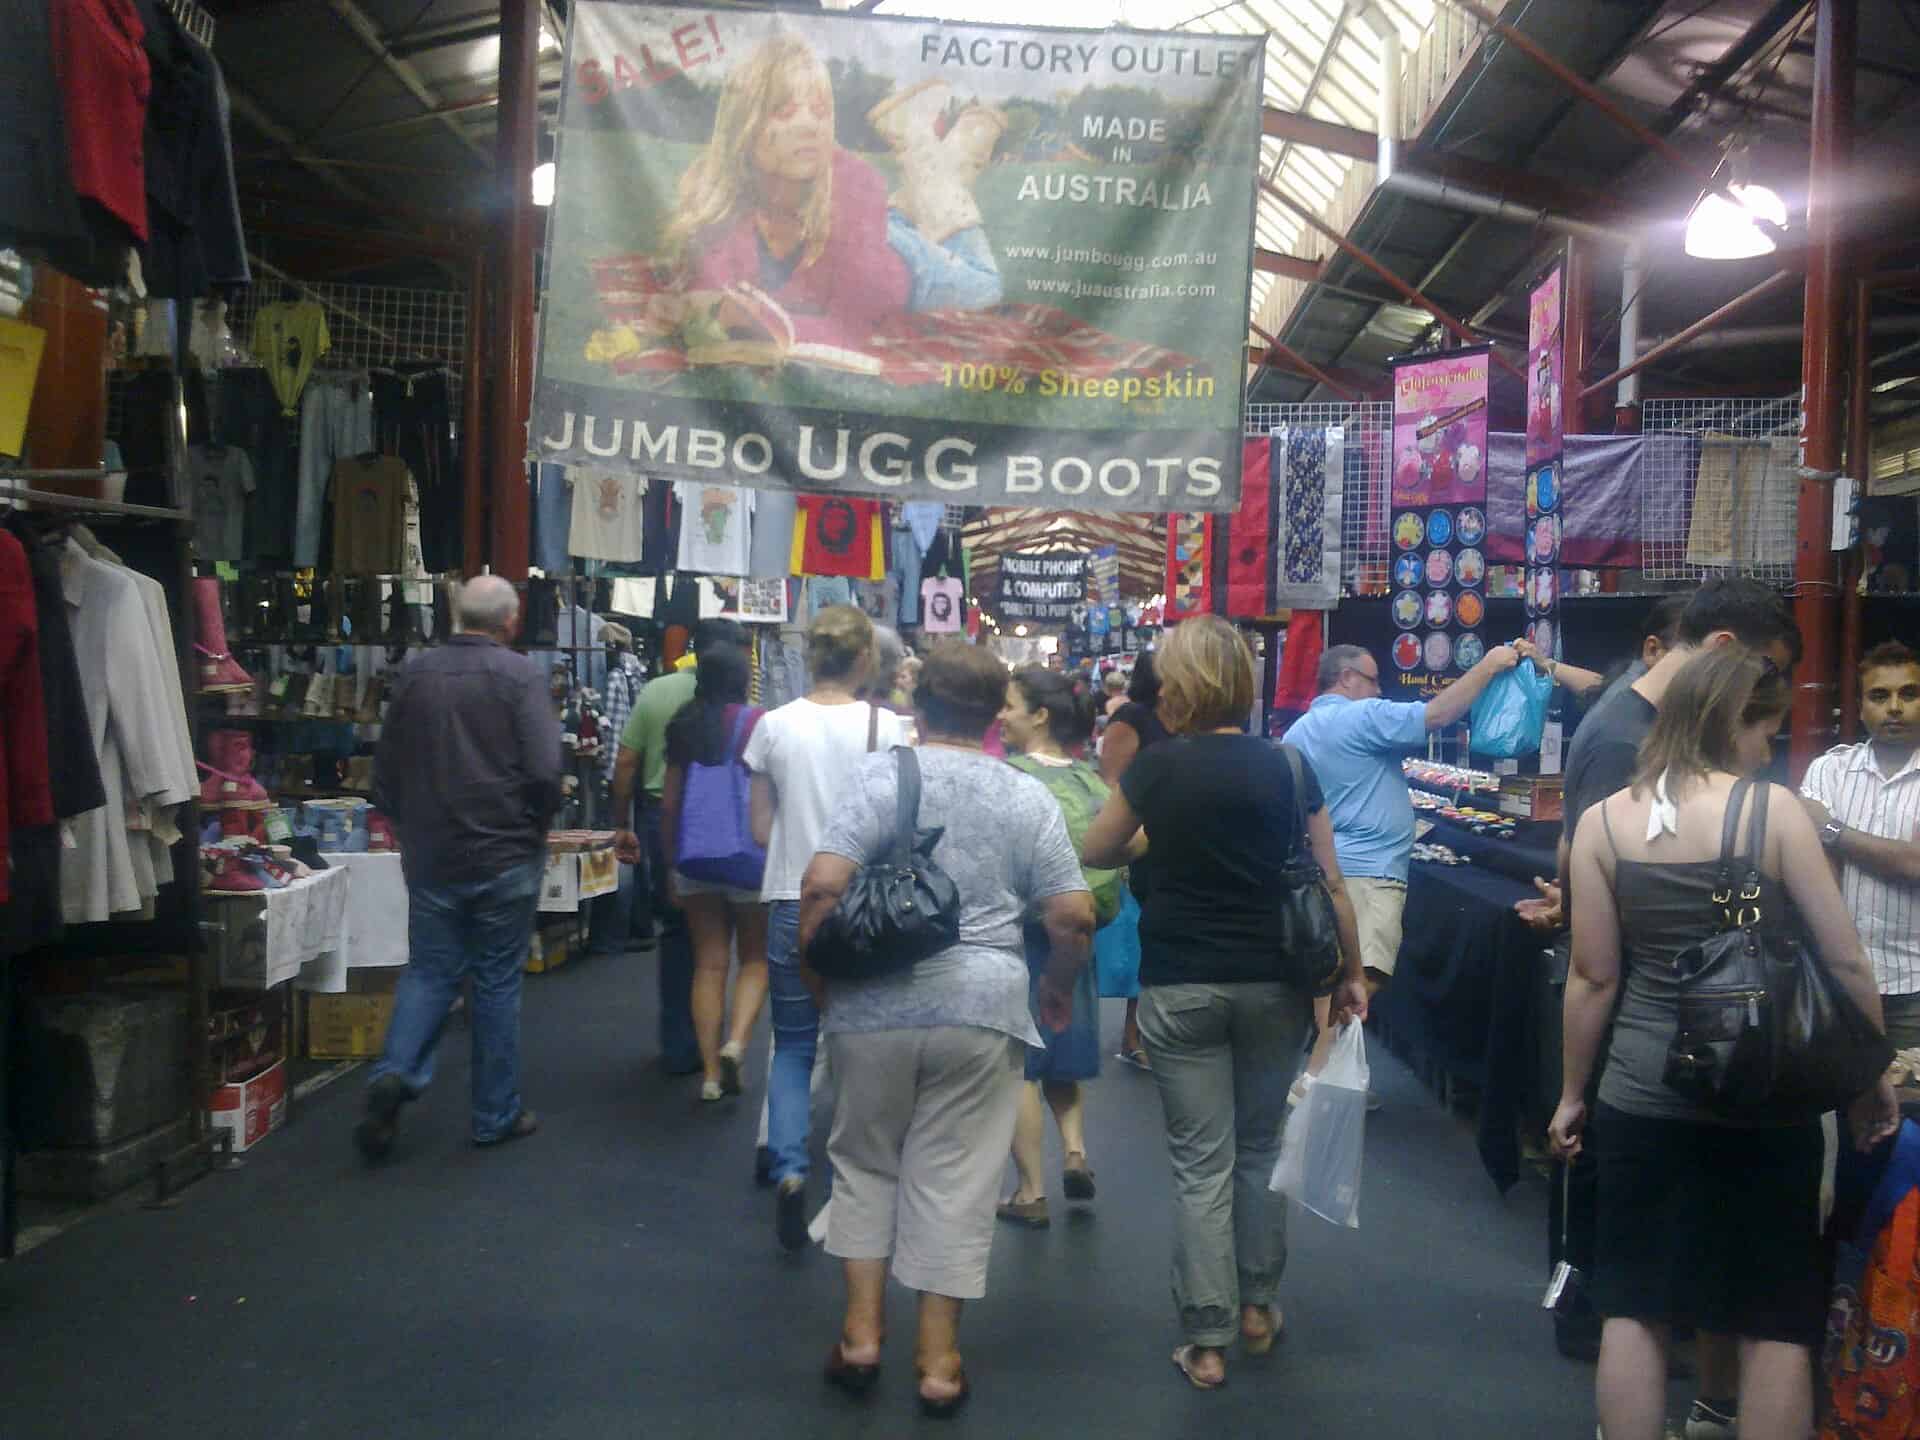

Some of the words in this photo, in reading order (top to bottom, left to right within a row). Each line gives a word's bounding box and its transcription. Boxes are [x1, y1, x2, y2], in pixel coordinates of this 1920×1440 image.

[576, 15, 726, 104] SALE!
[920, 34, 1099, 74] FACTORY
[1081, 114, 1168, 143] MADE
[1112, 144, 1132, 164] IN
[1017, 174, 1213, 212] AUSTRALIA
[1005, 244, 1217, 272] www.jumbougg.com.au
[1026, 277, 1217, 302] www.juaustralia.com
[943, 361, 1025, 395] 100%
[1038, 367, 1216, 404] Sheepskin
[543, 411, 773, 474] JUMBO
[796, 425, 980, 492] UGG
[1005, 455, 1223, 498] BOOTS
[1002, 557, 1041, 575] MOBILE
